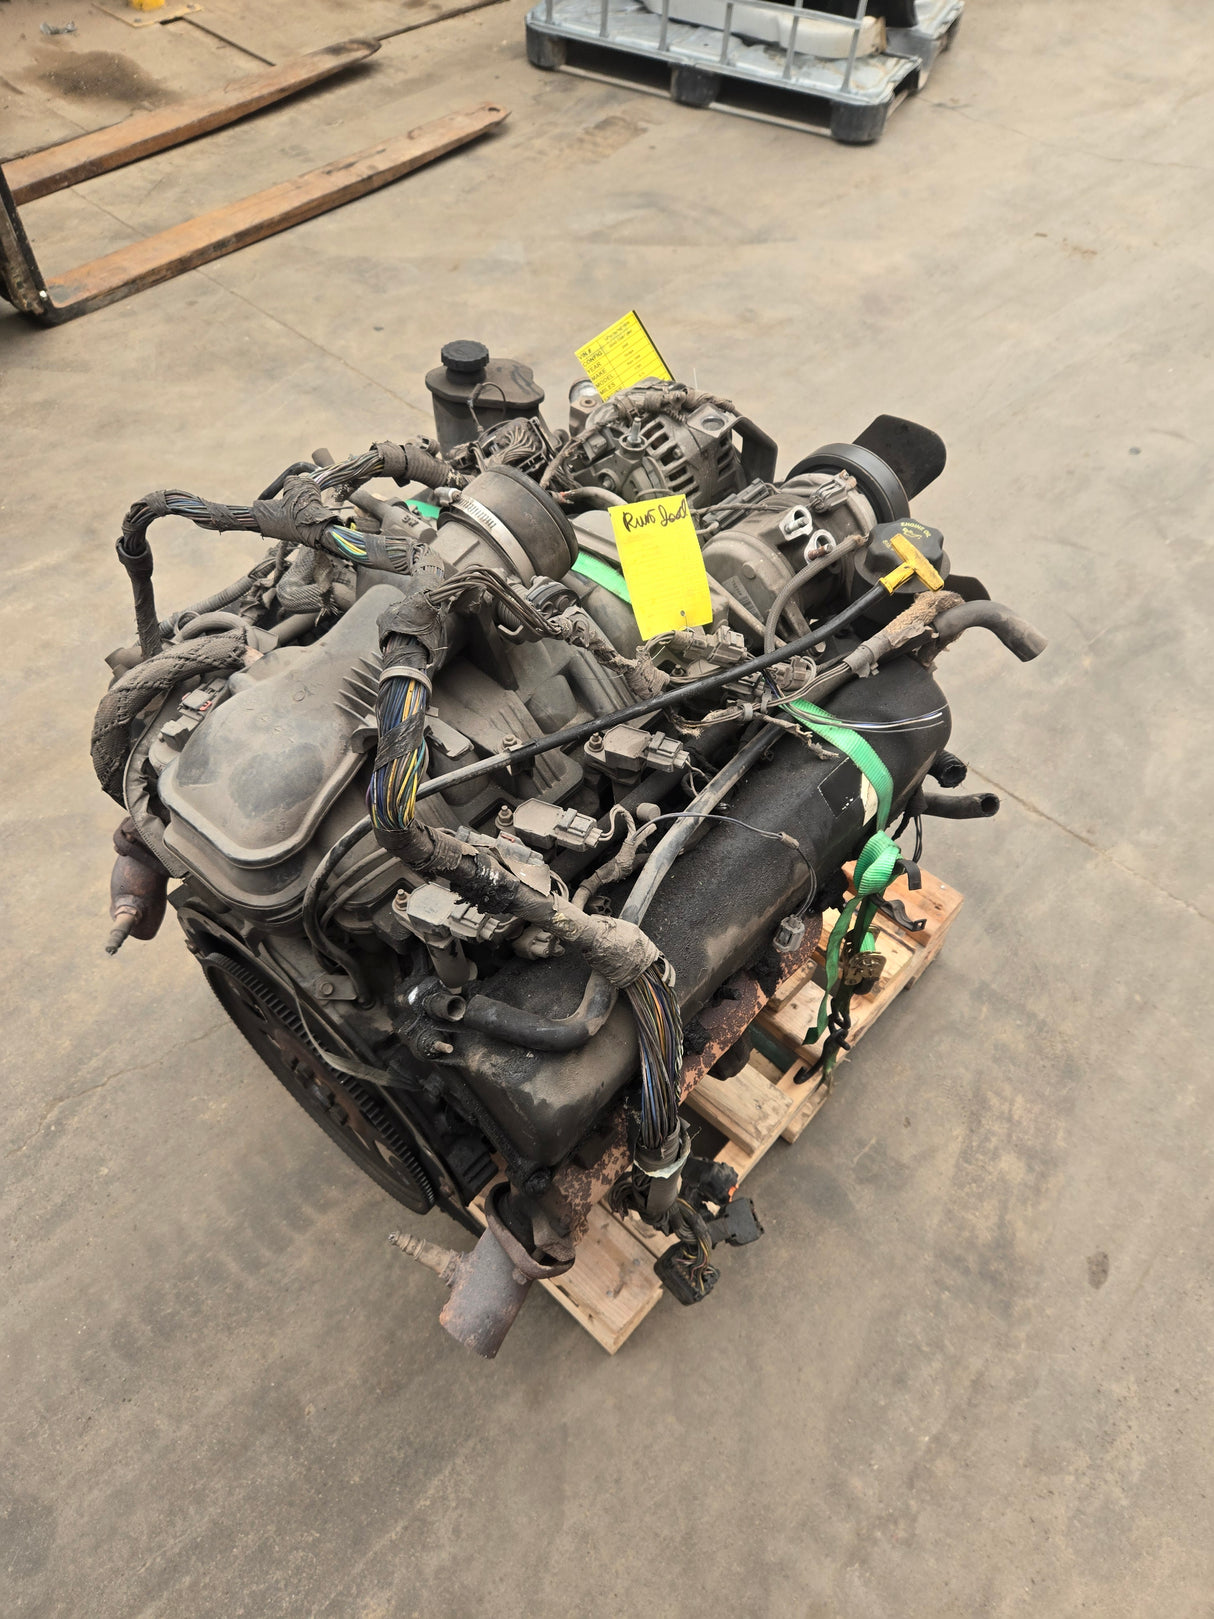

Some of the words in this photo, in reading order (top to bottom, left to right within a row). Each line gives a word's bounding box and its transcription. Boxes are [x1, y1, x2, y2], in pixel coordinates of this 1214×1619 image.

[582, 350, 602, 367] CONFIG
[586, 361, 601, 374] YEAR
[591, 367, 606, 381] MAKE
[595, 373, 613, 388] MODEL
[599, 381, 615, 395] MILES
[900, 521, 925, 532] ENGINE
